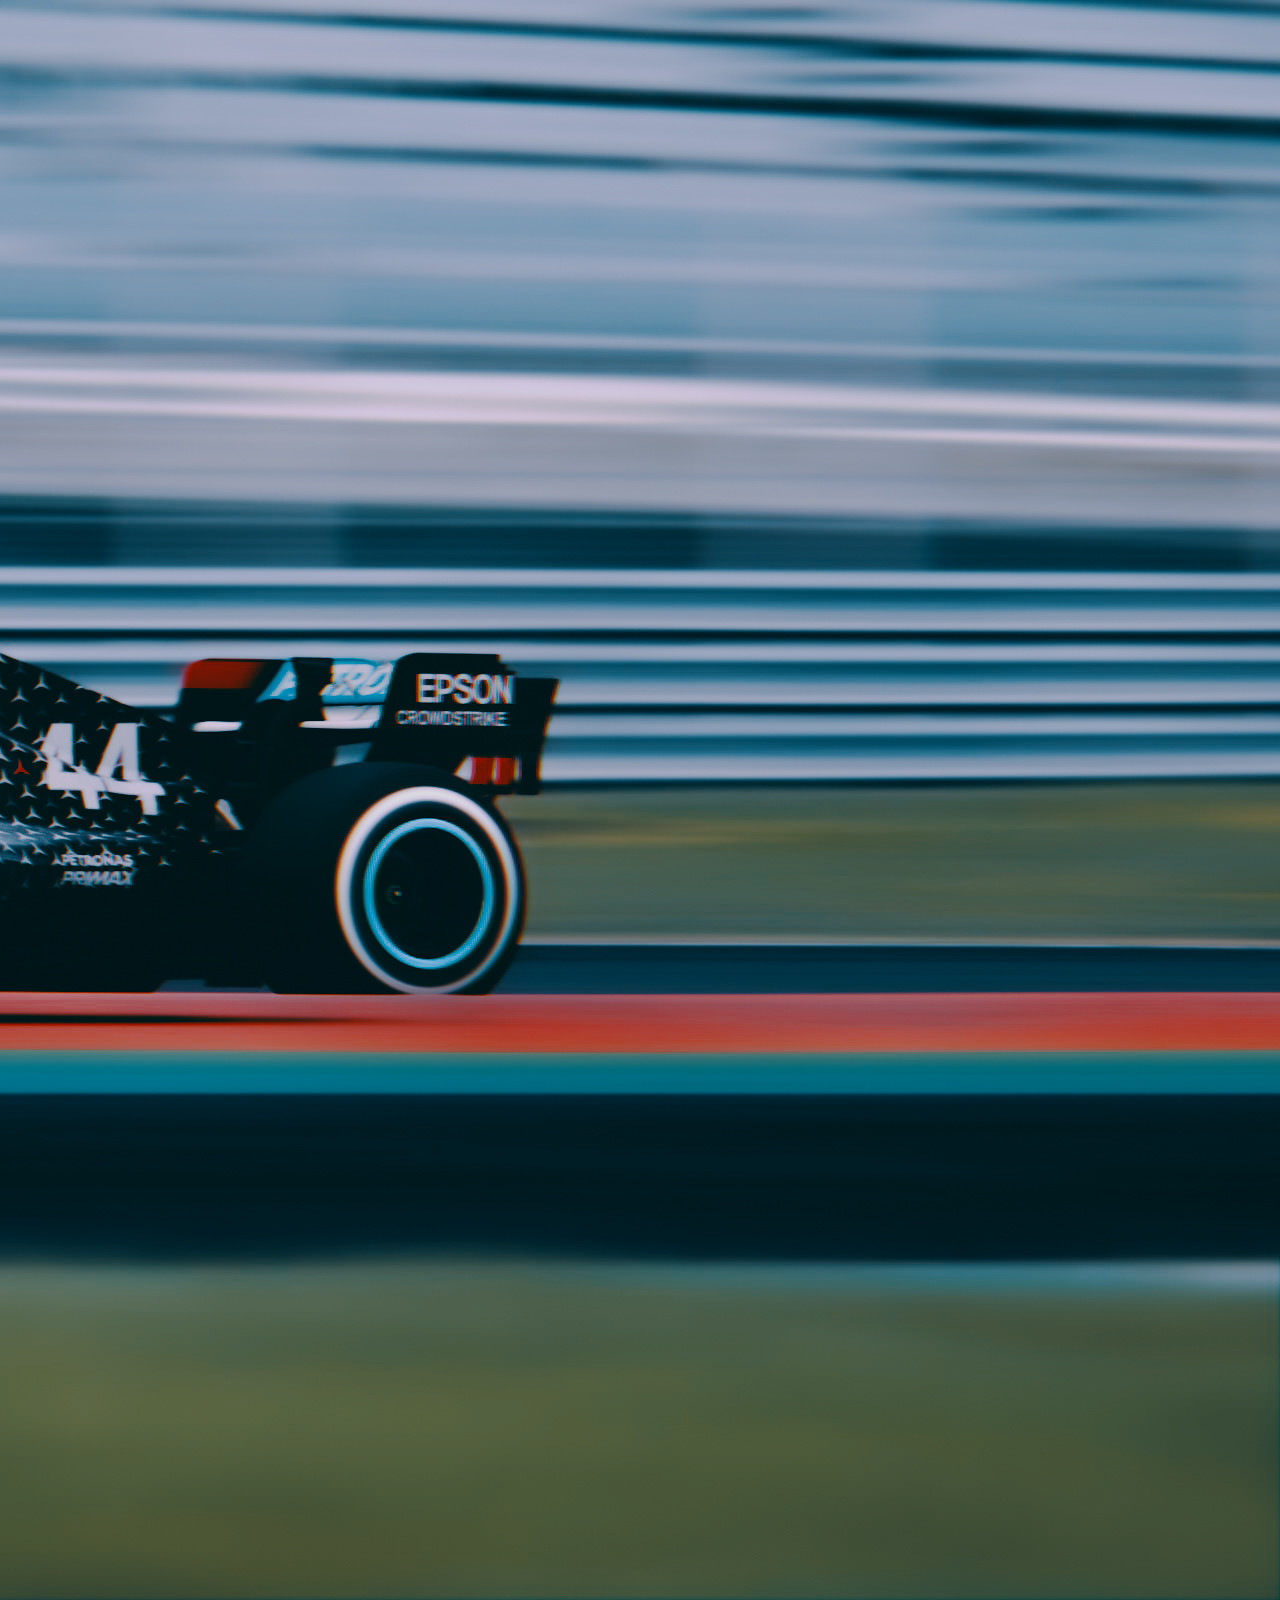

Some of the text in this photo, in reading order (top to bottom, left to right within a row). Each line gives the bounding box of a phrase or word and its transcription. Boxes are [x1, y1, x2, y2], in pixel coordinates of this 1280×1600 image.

[416, 673, 516, 704] EPSON
[396, 709, 510, 726] CROWDSTRIKE
[40, 723, 166, 816] 44
[61, 854, 134, 867] PETRONAS
